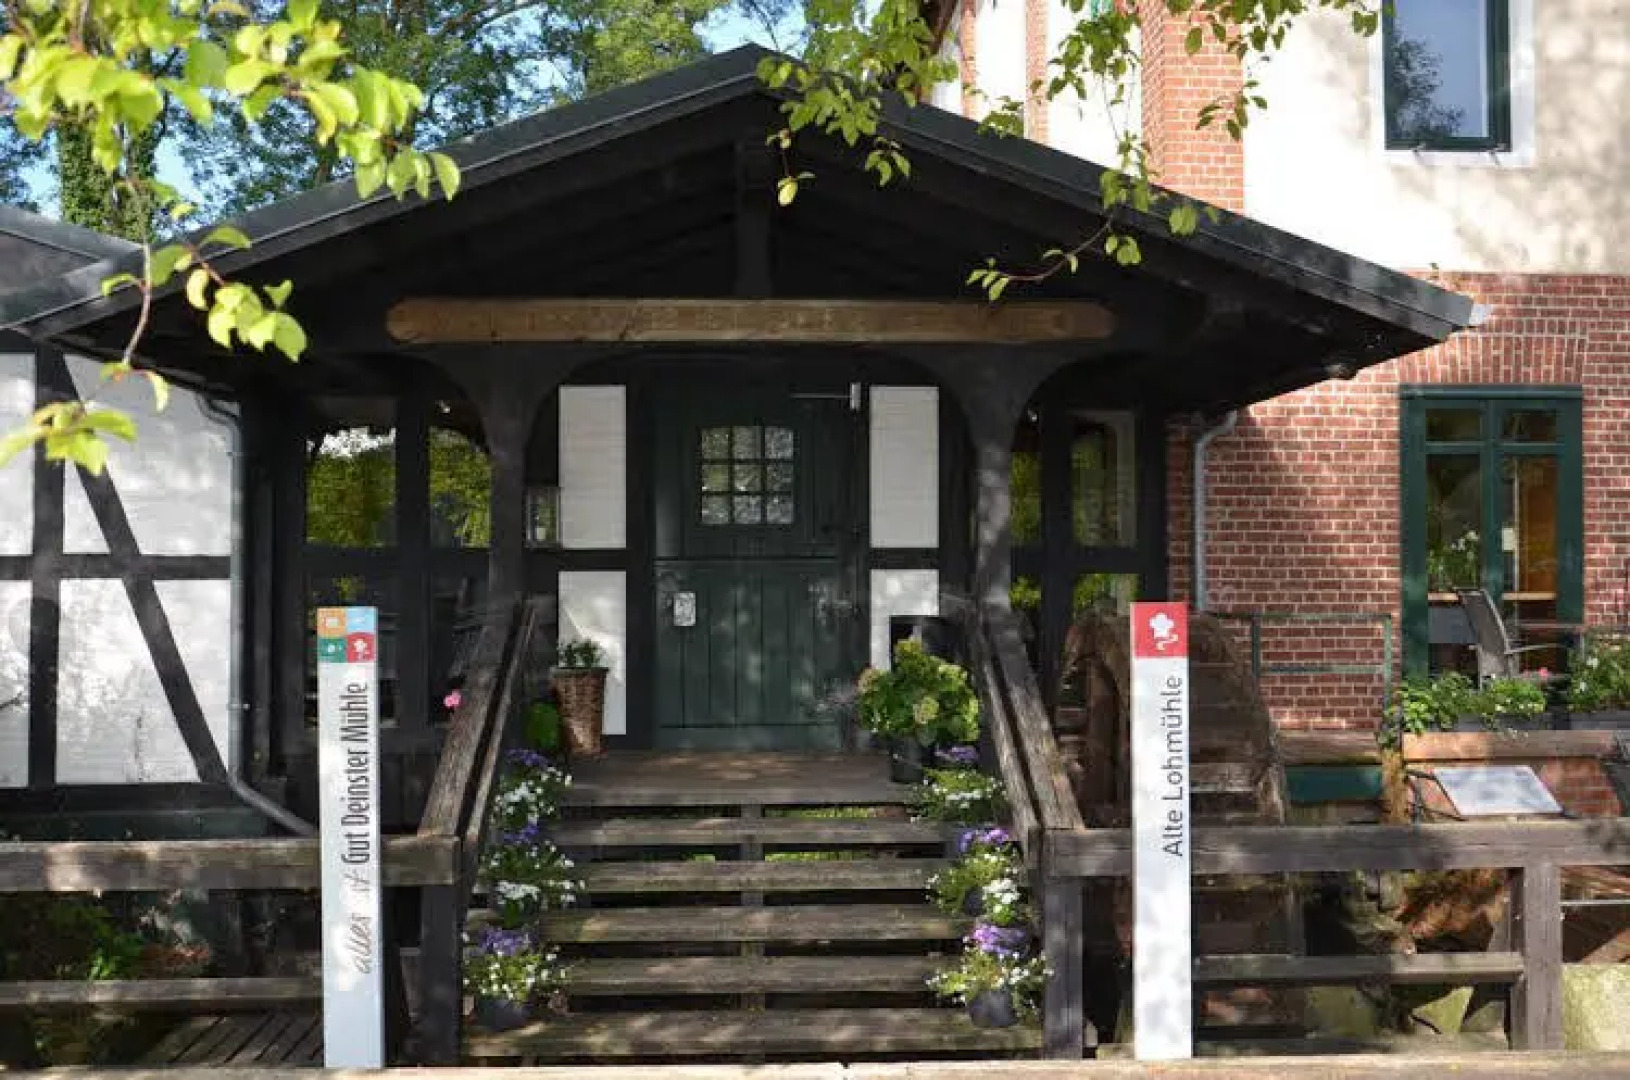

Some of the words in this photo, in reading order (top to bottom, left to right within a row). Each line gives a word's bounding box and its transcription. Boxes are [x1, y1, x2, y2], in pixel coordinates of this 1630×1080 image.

[339, 682, 369, 743] Mühle
[1160, 675, 1184, 801] Lohmühle
[340, 747, 370, 827] Deinster
[340, 831, 370, 864] Gut
[1162, 809, 1184, 857] Alte
